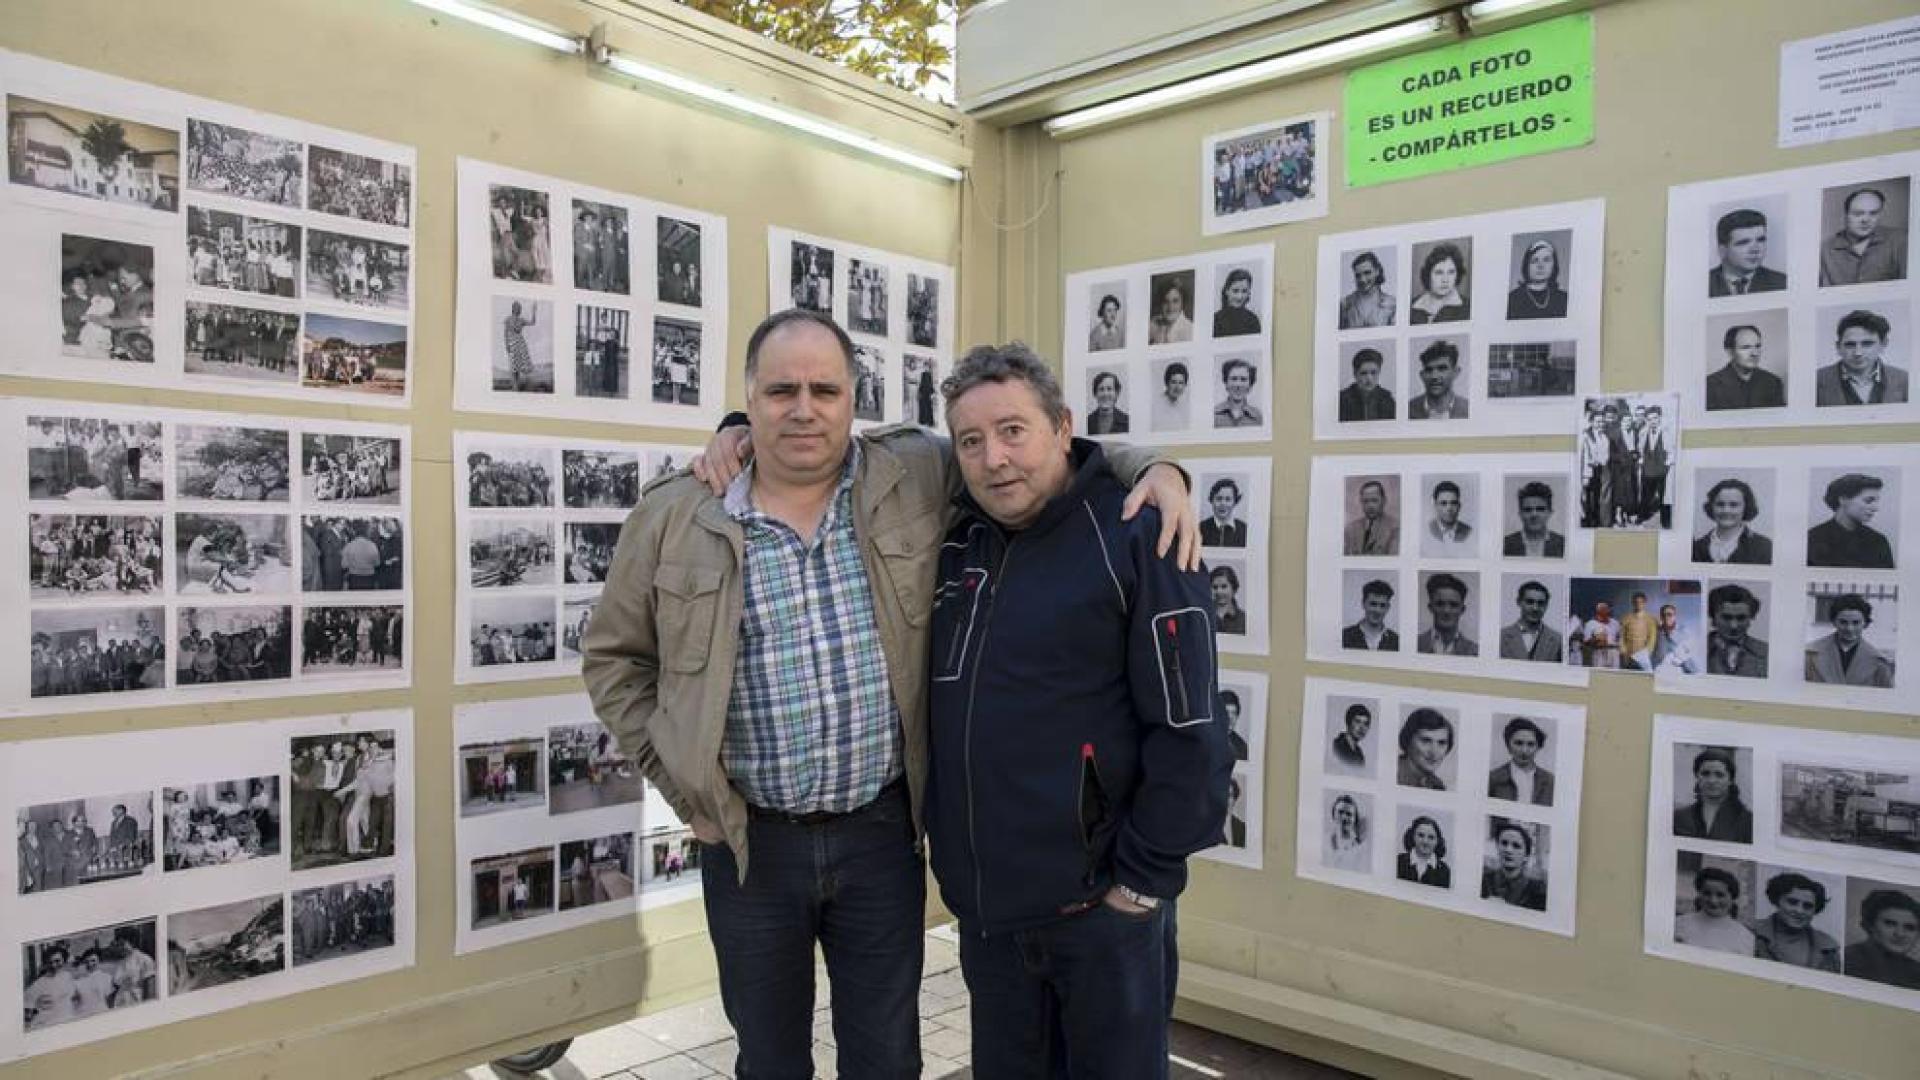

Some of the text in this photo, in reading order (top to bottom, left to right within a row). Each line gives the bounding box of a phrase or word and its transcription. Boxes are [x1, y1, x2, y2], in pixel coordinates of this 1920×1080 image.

[1401, 49, 1532, 94] CADA FOTO
[1368, 74, 1573, 135] ES UN RECUERDO
[1382, 113, 1556, 163] COMPÁRTELOS
